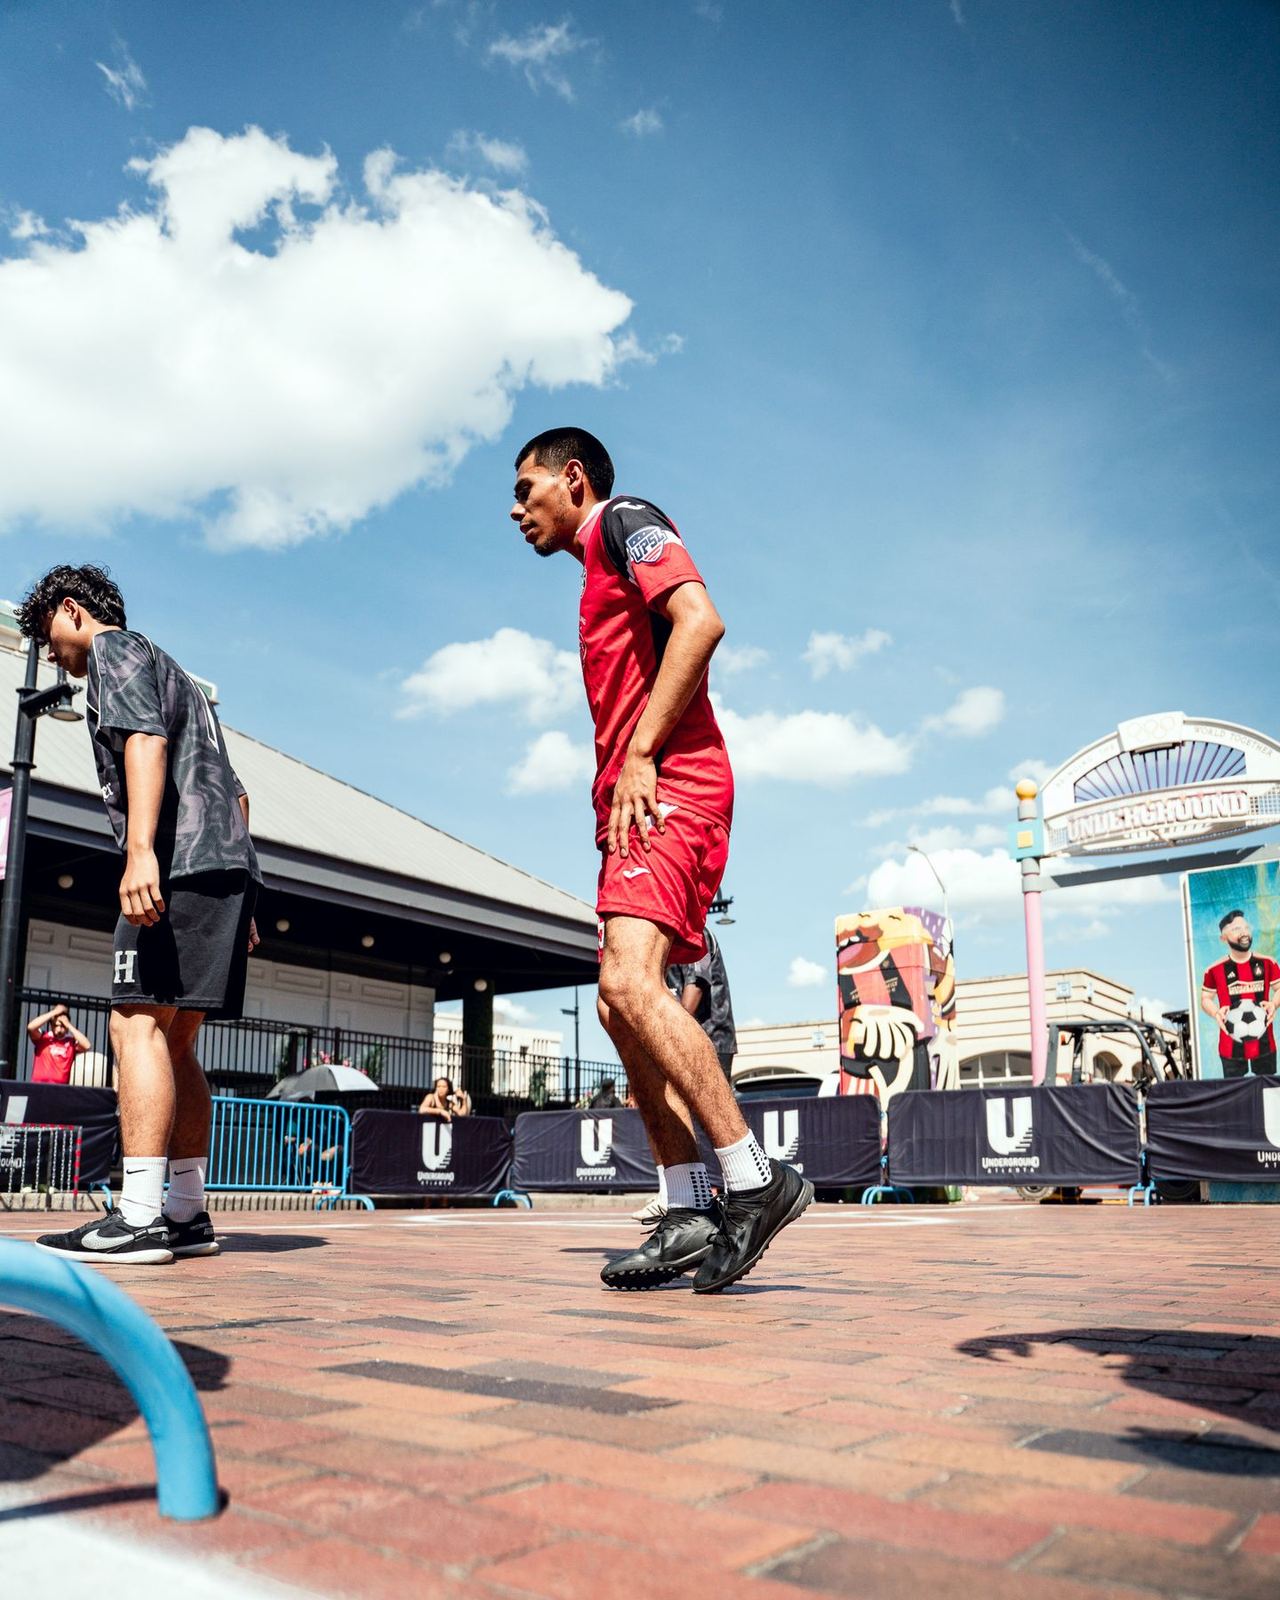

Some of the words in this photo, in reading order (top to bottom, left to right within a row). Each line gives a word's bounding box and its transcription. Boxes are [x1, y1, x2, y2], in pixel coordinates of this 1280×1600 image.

[631, 530, 665, 562] UPSL
[113, 950, 137, 984] H
[982, 1156, 1040, 1169] UNDERGROUND
